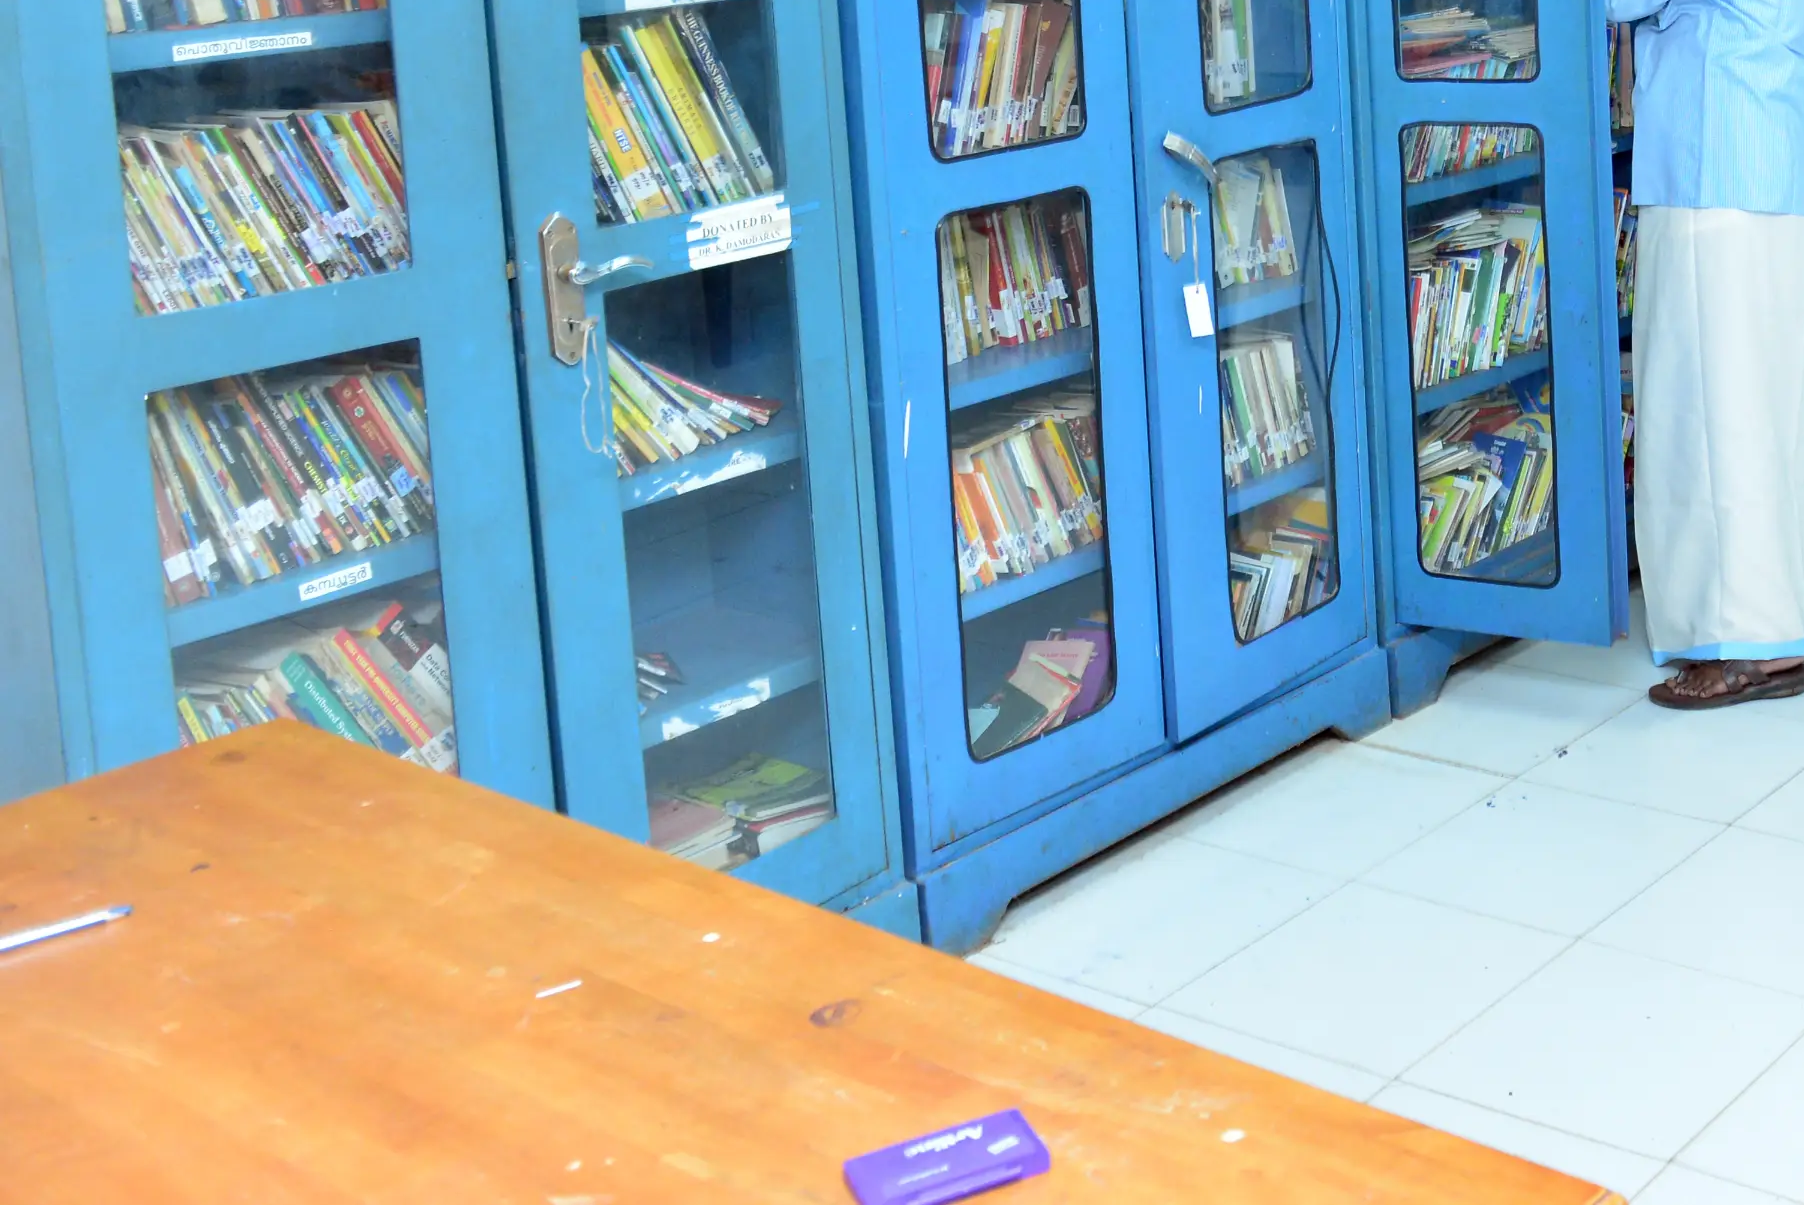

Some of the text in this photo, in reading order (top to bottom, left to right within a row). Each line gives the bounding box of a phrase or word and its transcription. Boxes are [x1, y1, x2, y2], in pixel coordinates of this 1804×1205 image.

[682, 11, 700, 33] THE
[690, 29, 721, 77] GUINNESS
[711, 74, 731, 99] BOOK
[721, 95, 735, 111] OF
[612, 126, 633, 154] NTSE
[702, 212, 773, 239] DONATED BY
[726, 229, 781, 252] DAMODARAN
[283, 429, 304, 458] SCIENCE
[319, 418, 343, 450] World's
[423, 652, 442, 671] Data
[301, 679, 341, 724] Distributed
